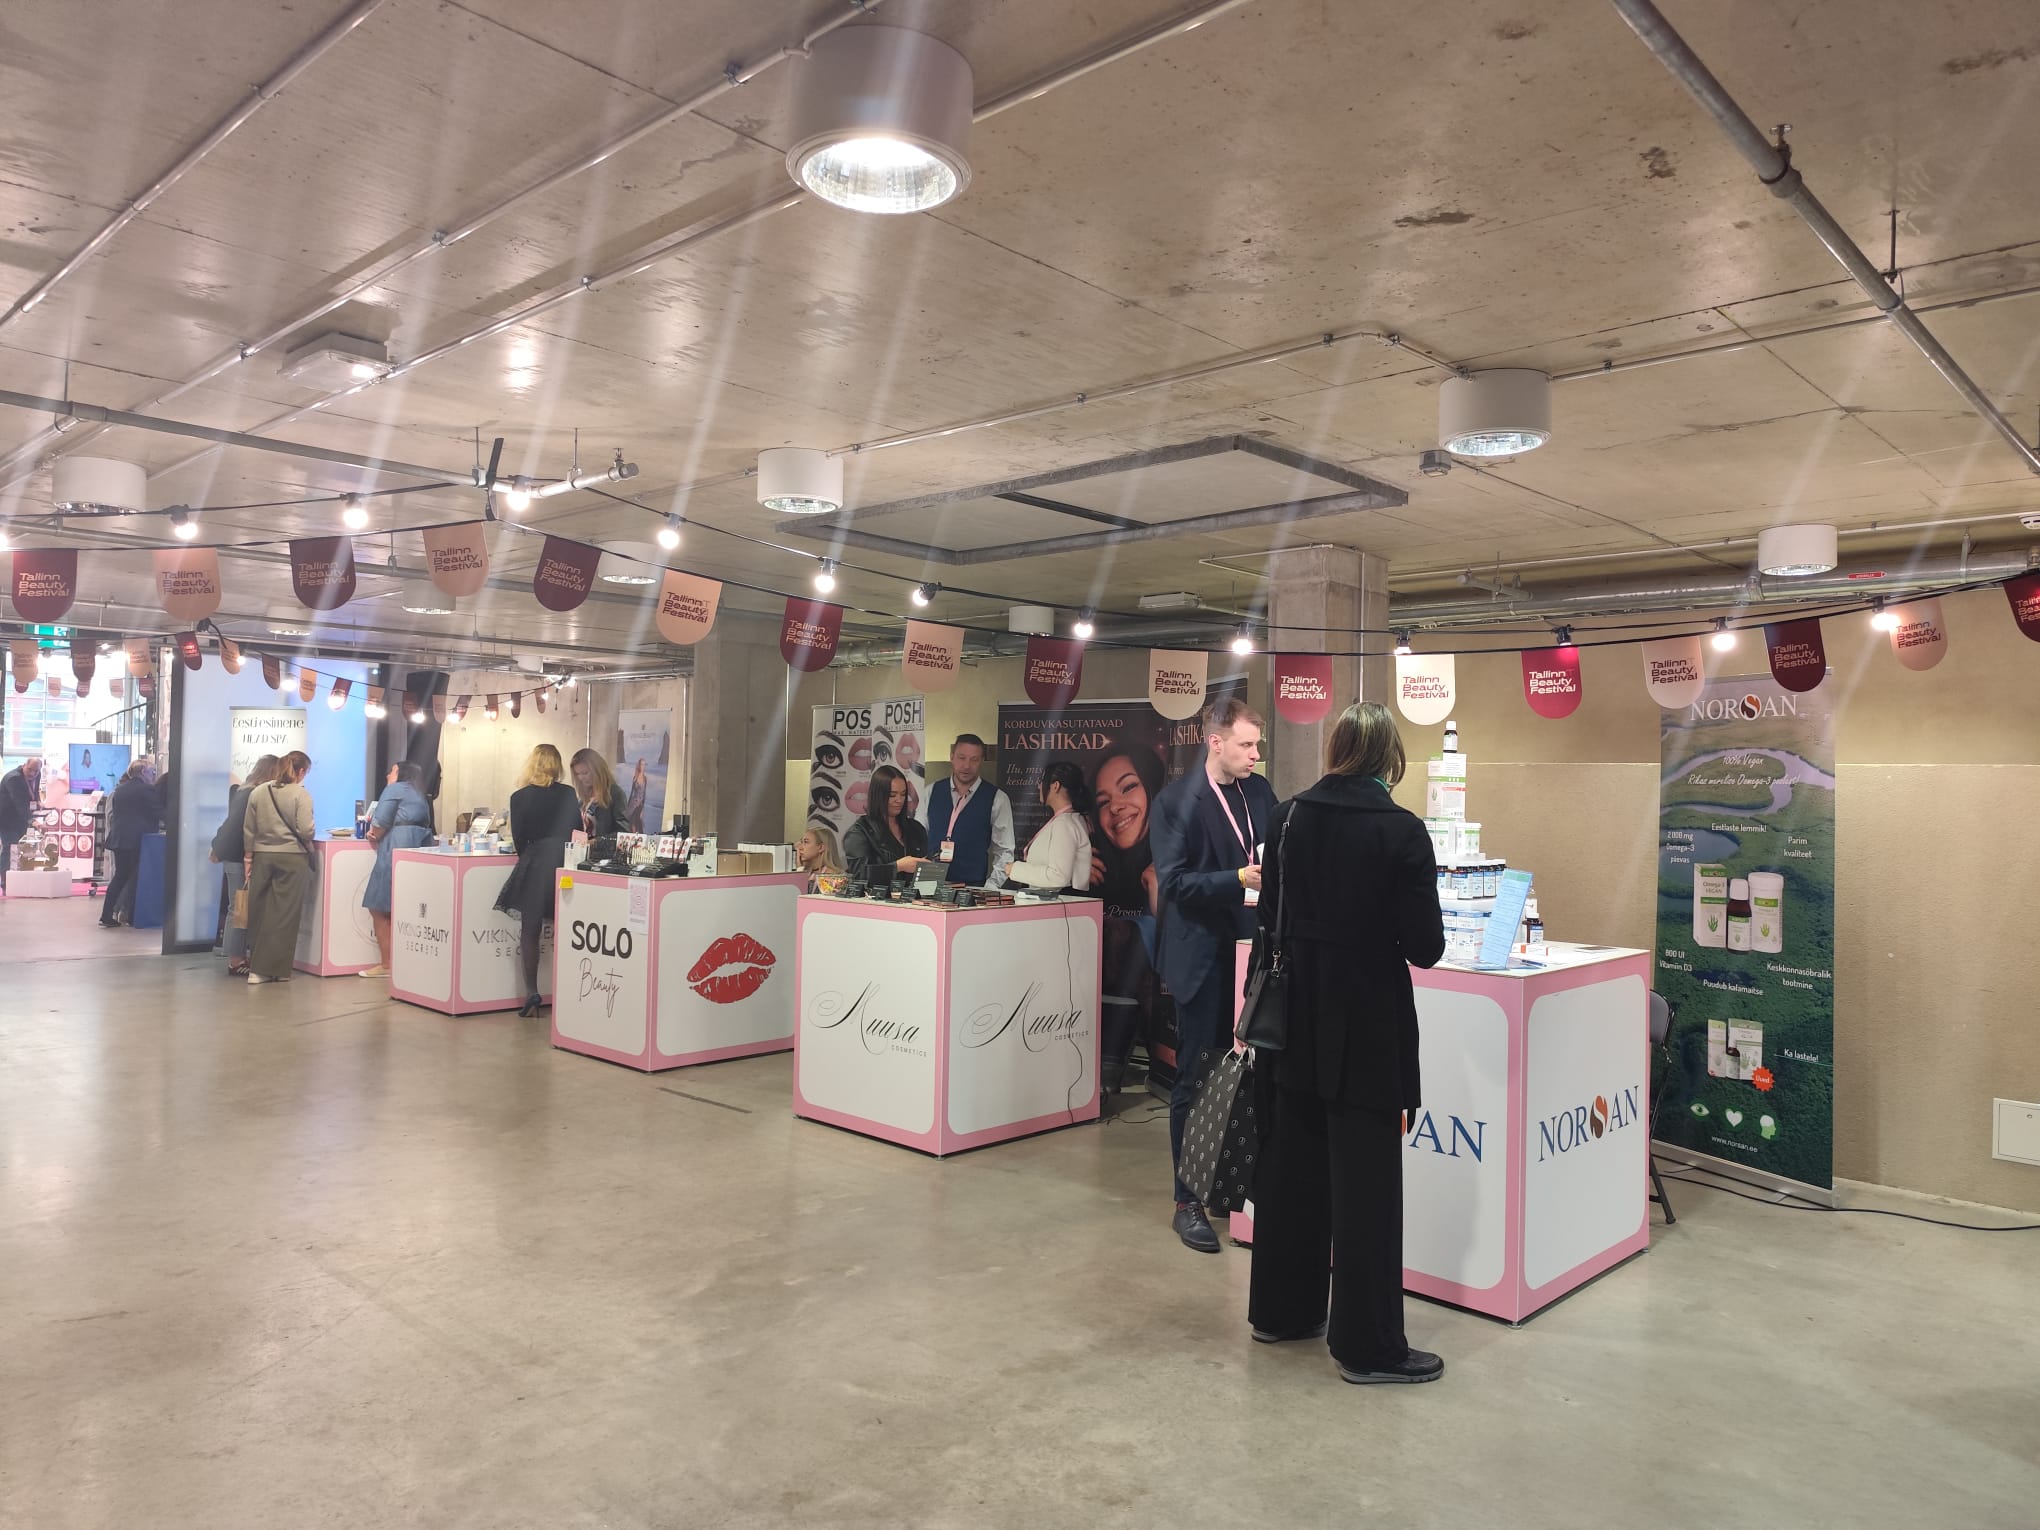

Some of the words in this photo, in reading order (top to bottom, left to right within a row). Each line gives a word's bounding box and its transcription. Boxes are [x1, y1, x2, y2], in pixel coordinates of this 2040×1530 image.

[432, 547, 472, 558] Tallinn
[299, 561, 339, 571] Tallinn
[433, 554, 478, 566] Beauty
[435, 560, 483, 573] Festival
[545, 558, 582, 575] Tallinn
[19, 573, 61, 581] Tallinn
[162, 571, 203, 580] Tallinn
[299, 569, 346, 579] Beauty
[543, 567, 585, 584] Beauty
[18, 581, 67, 589] Beauty
[162, 579, 210, 588] Beauty
[299, 576, 350, 587] Festival
[540, 573, 586, 592] Festival
[18, 588, 70, 597] Festival
[163, 586, 215, 596] Festival
[667, 591, 702, 605] Tallinn
[664, 600, 706, 615] Beauty
[2017, 605, 2040, 616] Bea
[663, 607, 708, 624] Festival
[789, 619, 826, 633] Tallinn
[1896, 620, 1930, 634] Tallinn
[787, 627, 830, 642] Beauty
[1896, 627, 1937, 641] Beauty
[786, 634, 832, 650] Festival
[1897, 633, 1942, 649] Festival
[911, 641, 947, 654] Tallinn
[1773, 641, 1809, 654] Tallinn
[909, 649, 951, 664] Beauty
[1774, 650, 1816, 662] Beauty
[907, 657, 954, 671] Festival
[1031, 658, 1068, 669] Tallinn
[1651, 659, 1687, 669] Tallinn
[1775, 657, 1820, 670] Festival
[1030, 666, 1072, 678] Beauty
[1156, 669, 1192, 679] Tallinn
[1529, 669, 1566, 680] Tallinn
[1651, 666, 1694, 677] Beauty
[1029, 674, 1075, 686] Festival
[1155, 677, 1198, 688] Beauty
[1280, 675, 1318, 684] Tallinn
[1402, 676, 1440, 684] Tallinn
[1529, 677, 1573, 687] Beauty
[1652, 672, 1698, 685] Festival
[1154, 685, 1200, 696] Festival
[1280, 683, 1324, 693] Beauty
[1402, 683, 1446, 692] Beauty
[1530, 684, 1576, 695] Festival
[1279, 690, 1327, 700] Festival
[1402, 690, 1449, 700] Festival
[1690, 693, 1799, 721] NORSAN
[834, 709, 872, 730] POS
[885, 701, 922, 726] POSH
[1004, 719, 1124, 729] KORDUVKASUTATAVAD
[1169, 723, 1206, 746] LASHIKA
[1004, 732, 1106, 751] LASHIKAD
[1723, 755, 1740, 766] 100%
[1742, 753, 1764, 769] Vegan
[1711, 823, 1739, 832] Eestlaste
[1740, 823, 1767, 833] lemmik!
[1683, 832, 1694, 841] mg
[1788, 836, 1808, 845] Parim
[1783, 848, 1813, 858] kvaliteet
[423, 926, 450, 944] BEAUTY
[472, 929, 522, 944] VIKIN
[571, 919, 633, 960] SOLO
[1659, 960, 1683, 971] Vitamiin
[1683, 963, 1693, 972] D3
[579, 957, 624, 1018] Beauty
[1703, 979, 1728, 990] Puudub
[1728, 983, 1764, 996] kalamaitse
[1782, 978, 1814, 990] tootmine
[808, 980, 920, 1055] Muusa
[890, 1043, 928, 1058] COSMETICS
[1784, 1047, 1794, 1058] Ka
[1794, 1050, 1819, 1063] lastele!
[1755, 1074, 1770, 1084] Uued
[1538, 1085, 1639, 1162] NORSAN
